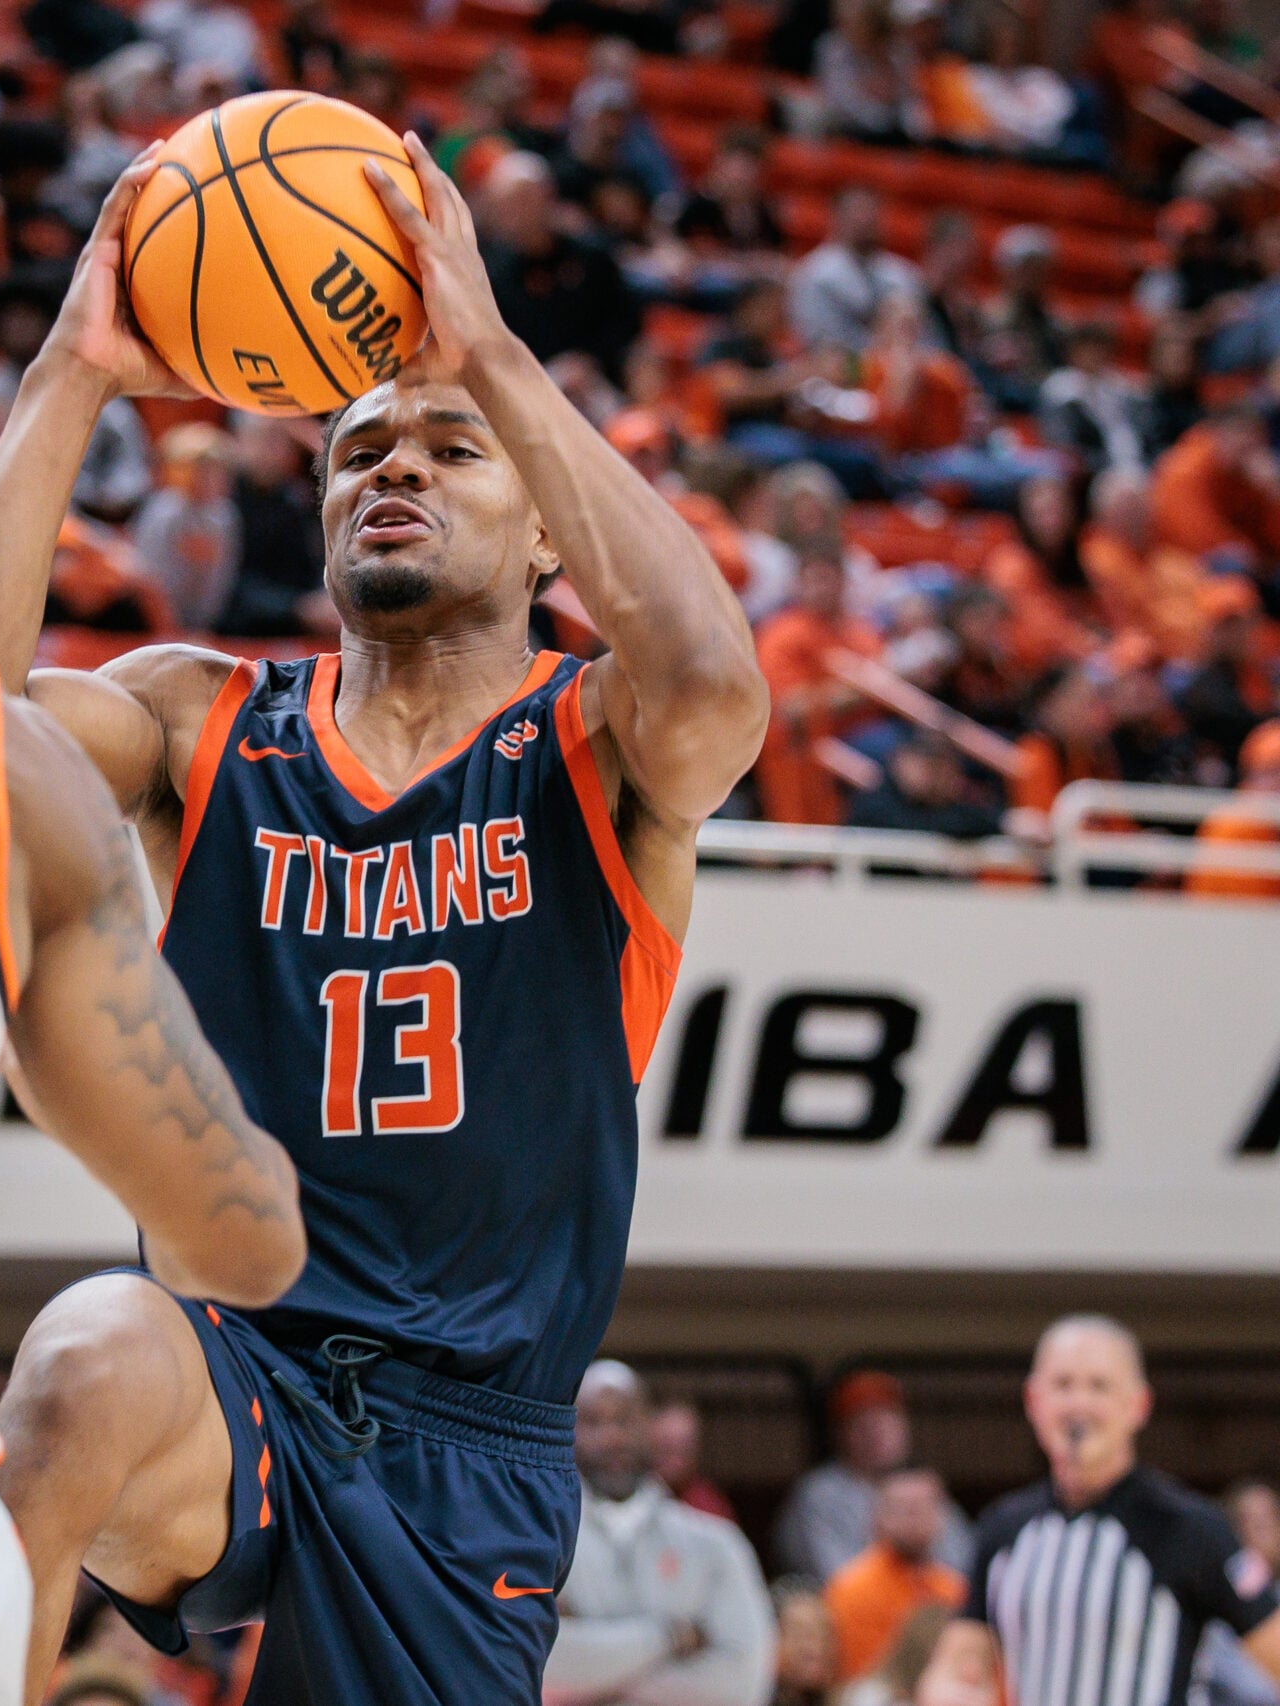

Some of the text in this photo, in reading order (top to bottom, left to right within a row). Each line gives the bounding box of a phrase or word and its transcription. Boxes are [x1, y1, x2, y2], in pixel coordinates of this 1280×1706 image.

[311, 248, 403, 381] Wilso
[255, 815, 533, 941] TITANS
[320, 960, 465, 1138] 13
[662, 985, 1091, 1151] IBA
